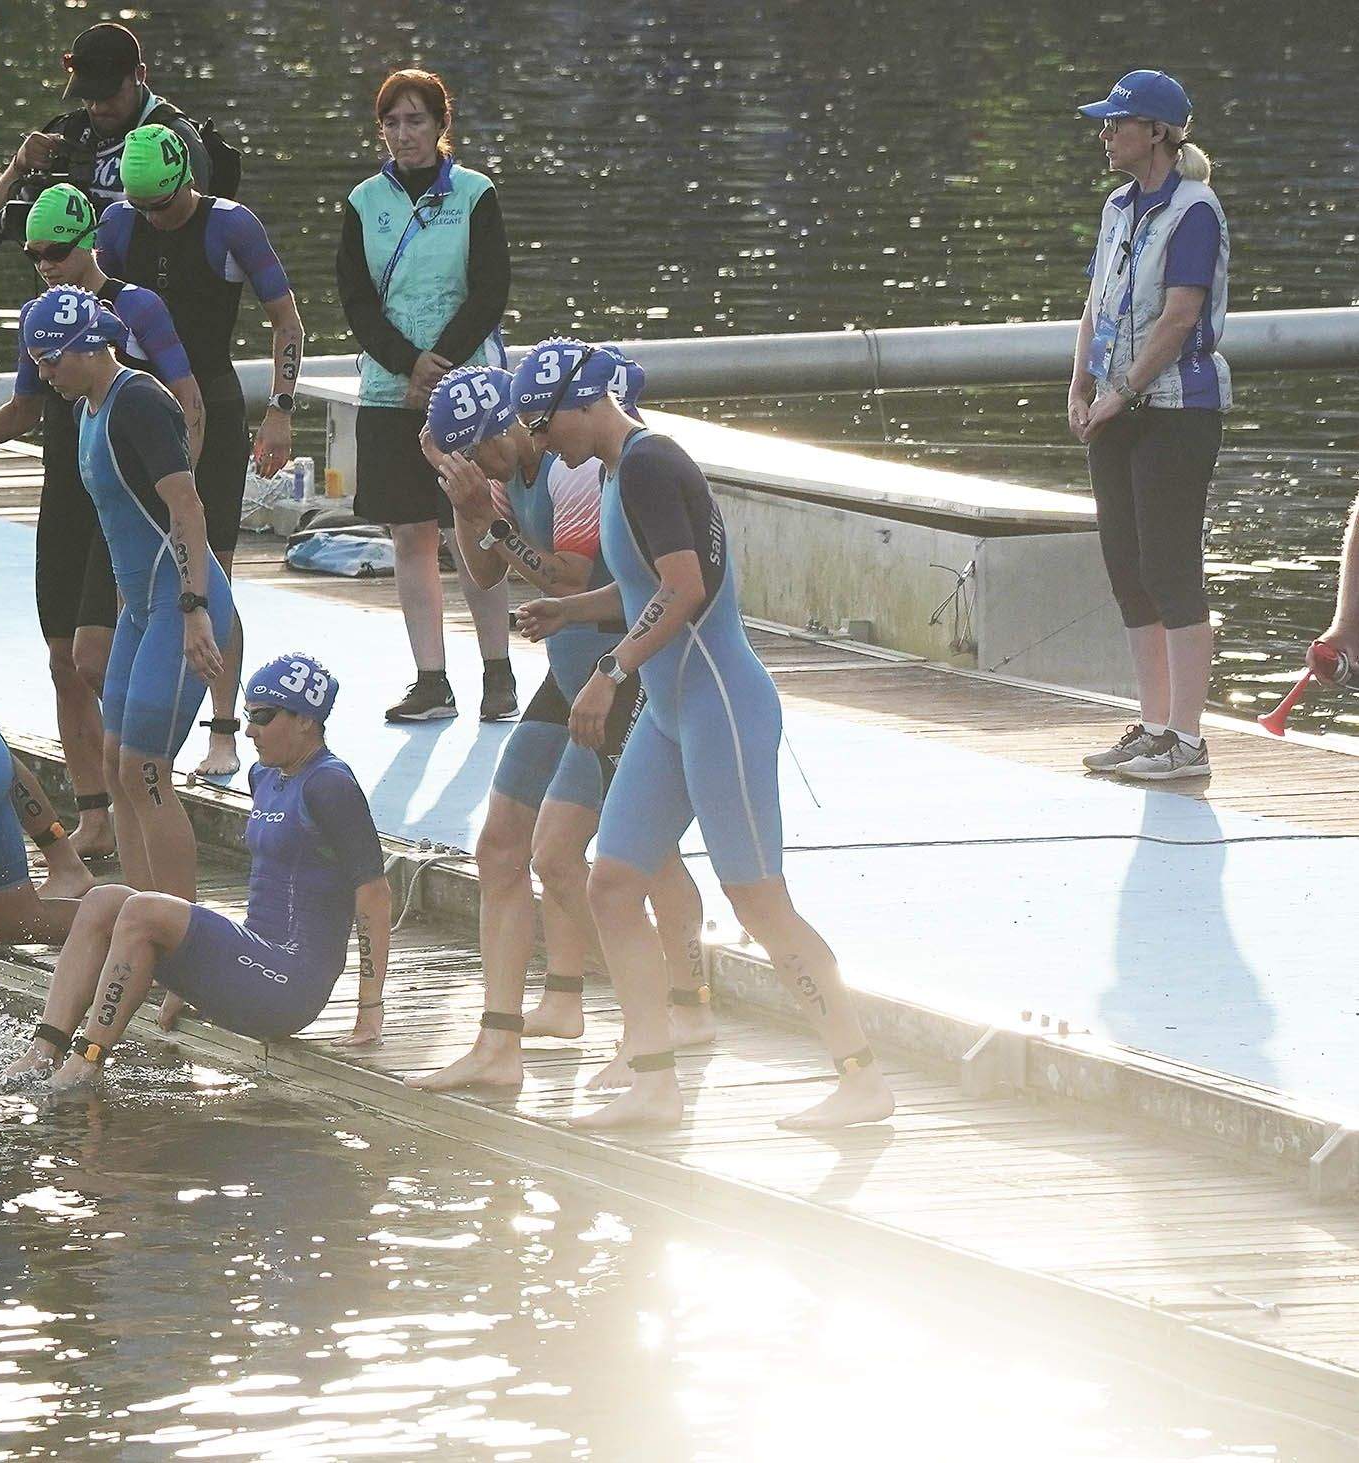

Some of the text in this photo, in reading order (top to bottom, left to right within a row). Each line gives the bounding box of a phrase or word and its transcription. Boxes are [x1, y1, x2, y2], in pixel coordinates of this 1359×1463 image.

[53, 294, 98, 329] 31
[282, 343, 298, 380] 43
[535, 350, 584, 385] 37
[449, 373, 500, 420] 35
[534, 392, 553, 400] NTT
[458, 425, 476, 437] NTT
[505, 534, 542, 571] 35
[630, 602, 665, 641] 37
[268, 689, 288, 700] NTT
[279, 661, 328, 707] 33
[143, 762, 162, 806] 31
[251, 809, 285, 823] orca
[237, 955, 289, 984] orca
[98, 982, 124, 1027] 33
